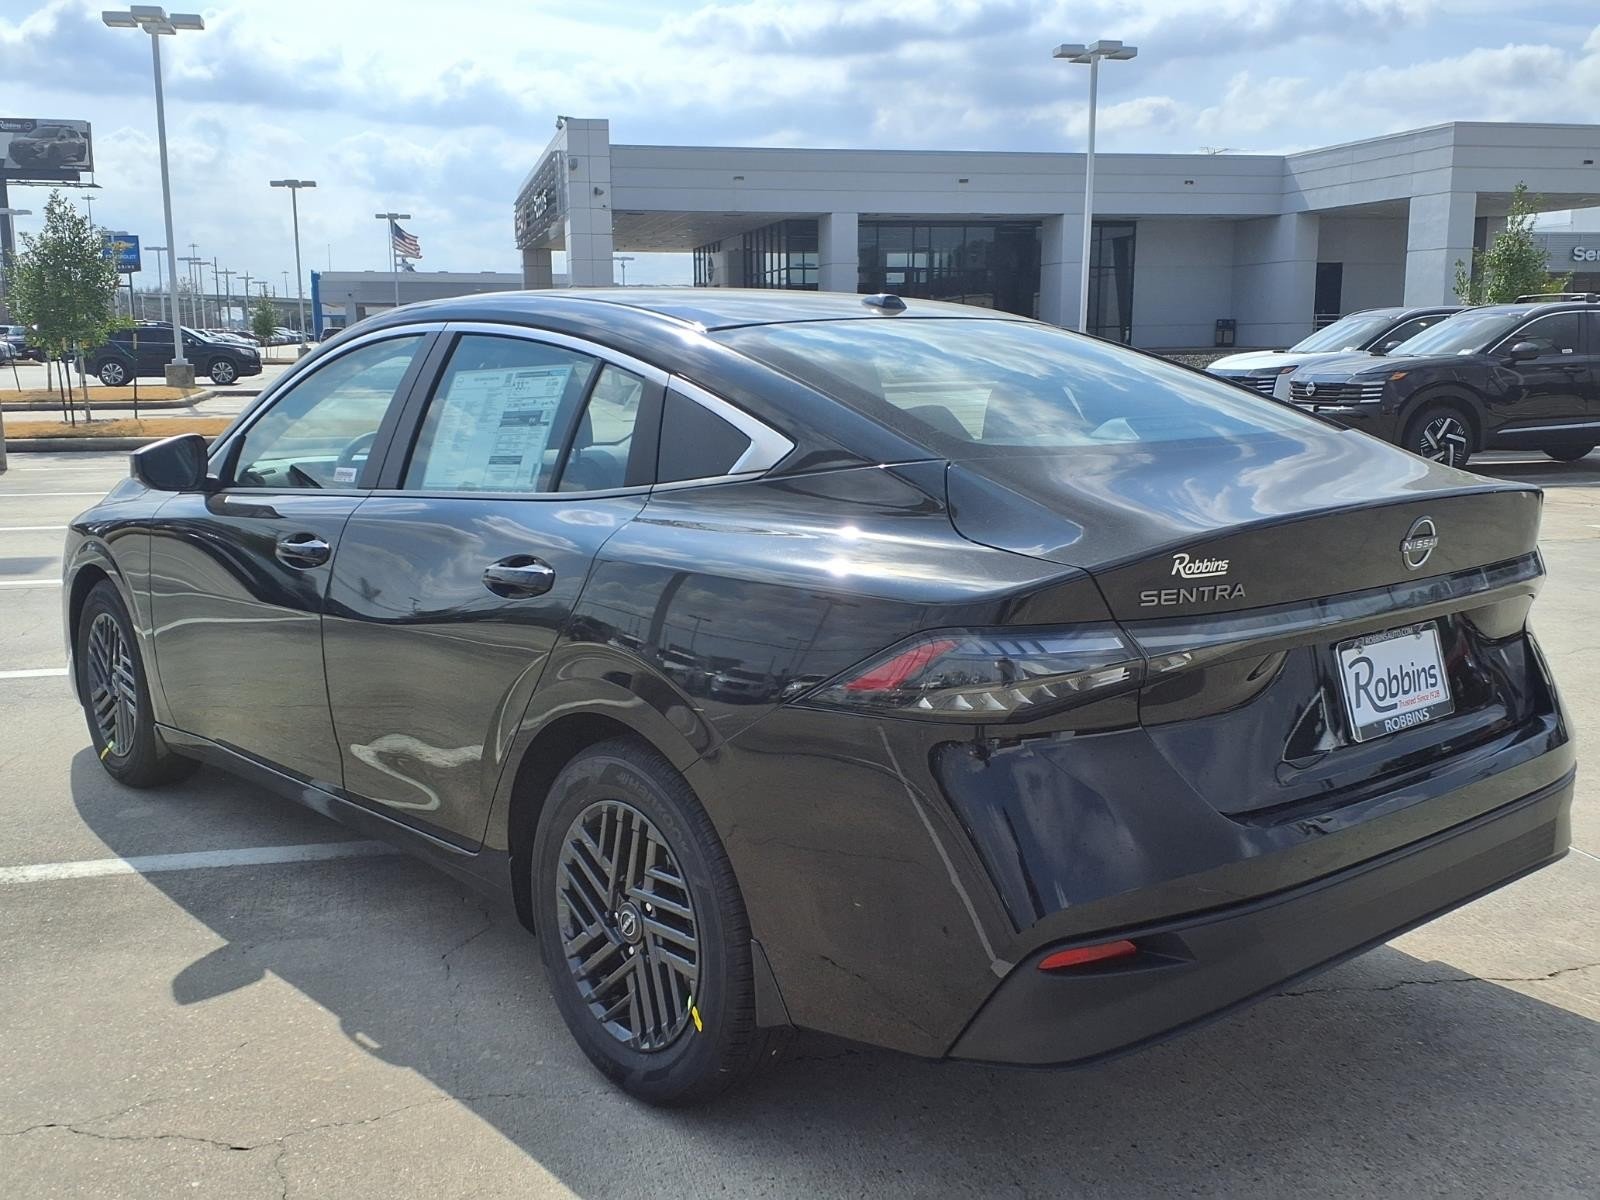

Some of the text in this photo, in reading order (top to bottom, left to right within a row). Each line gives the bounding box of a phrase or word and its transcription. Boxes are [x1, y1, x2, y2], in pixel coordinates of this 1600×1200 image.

[1403, 537, 1439, 551] NISSAN
[1171, 552, 1230, 579] Robbins
[1139, 583, 1246, 608] SENTRA
[1348, 655, 1438, 714] Robbins
[1398, 696, 1417, 708] Trusted
[1417, 694, 1430, 704] Since
[1385, 707, 1430, 732] ROBBINS
